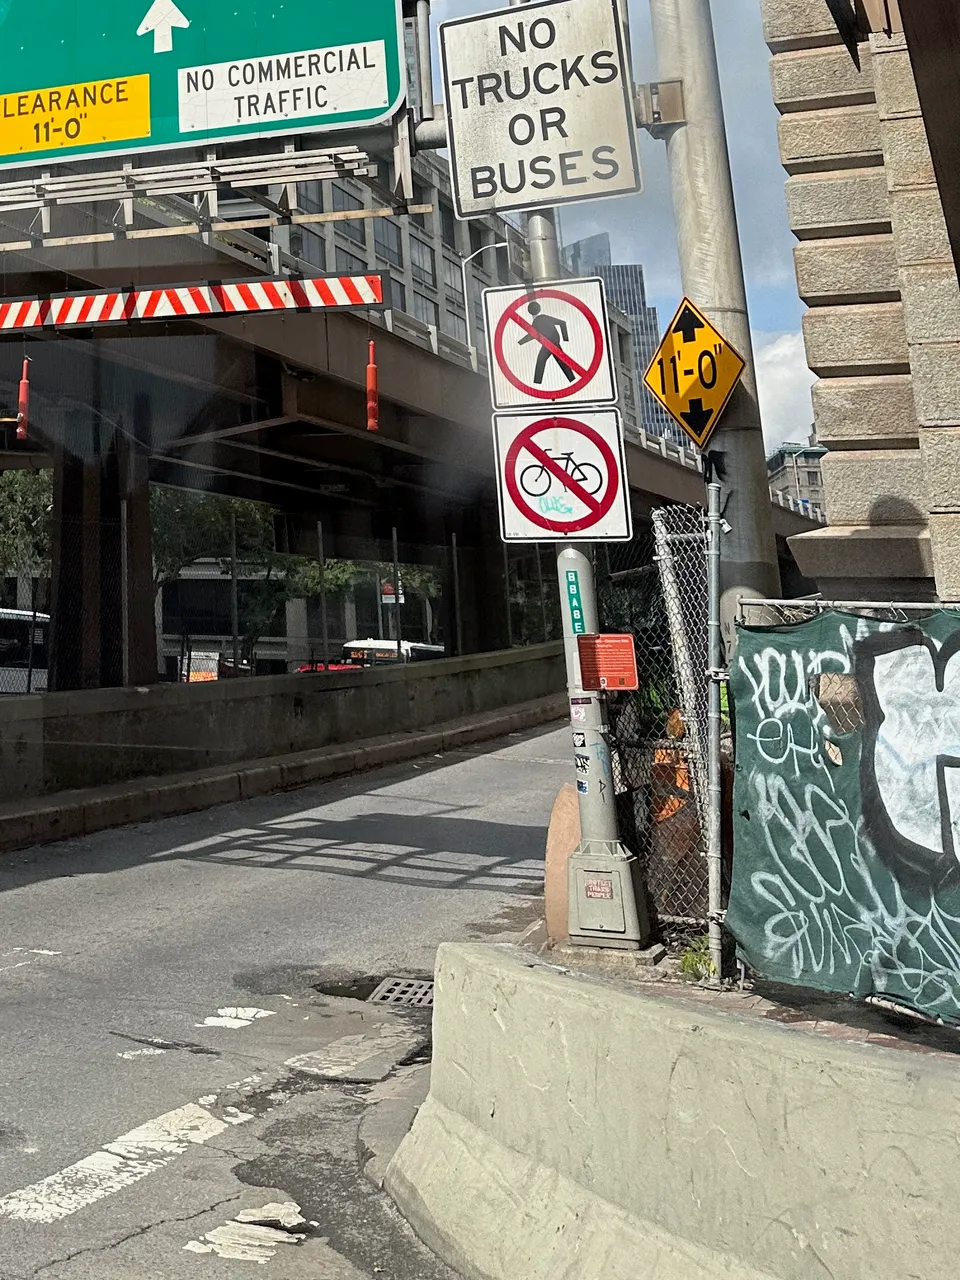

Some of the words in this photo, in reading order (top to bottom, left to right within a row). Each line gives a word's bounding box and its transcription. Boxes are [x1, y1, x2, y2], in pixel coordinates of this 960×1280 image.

[499, 18, 556, 56] NO
[186, 68, 214, 92] NO
[227, 45, 376, 87] COMMERCIAL
[451, 51, 618, 108] TRUCKS
[234, 85, 328, 118] TRAFFIC
[508, 107, 568, 145] OR
[470, 146, 620, 199] BUSES
